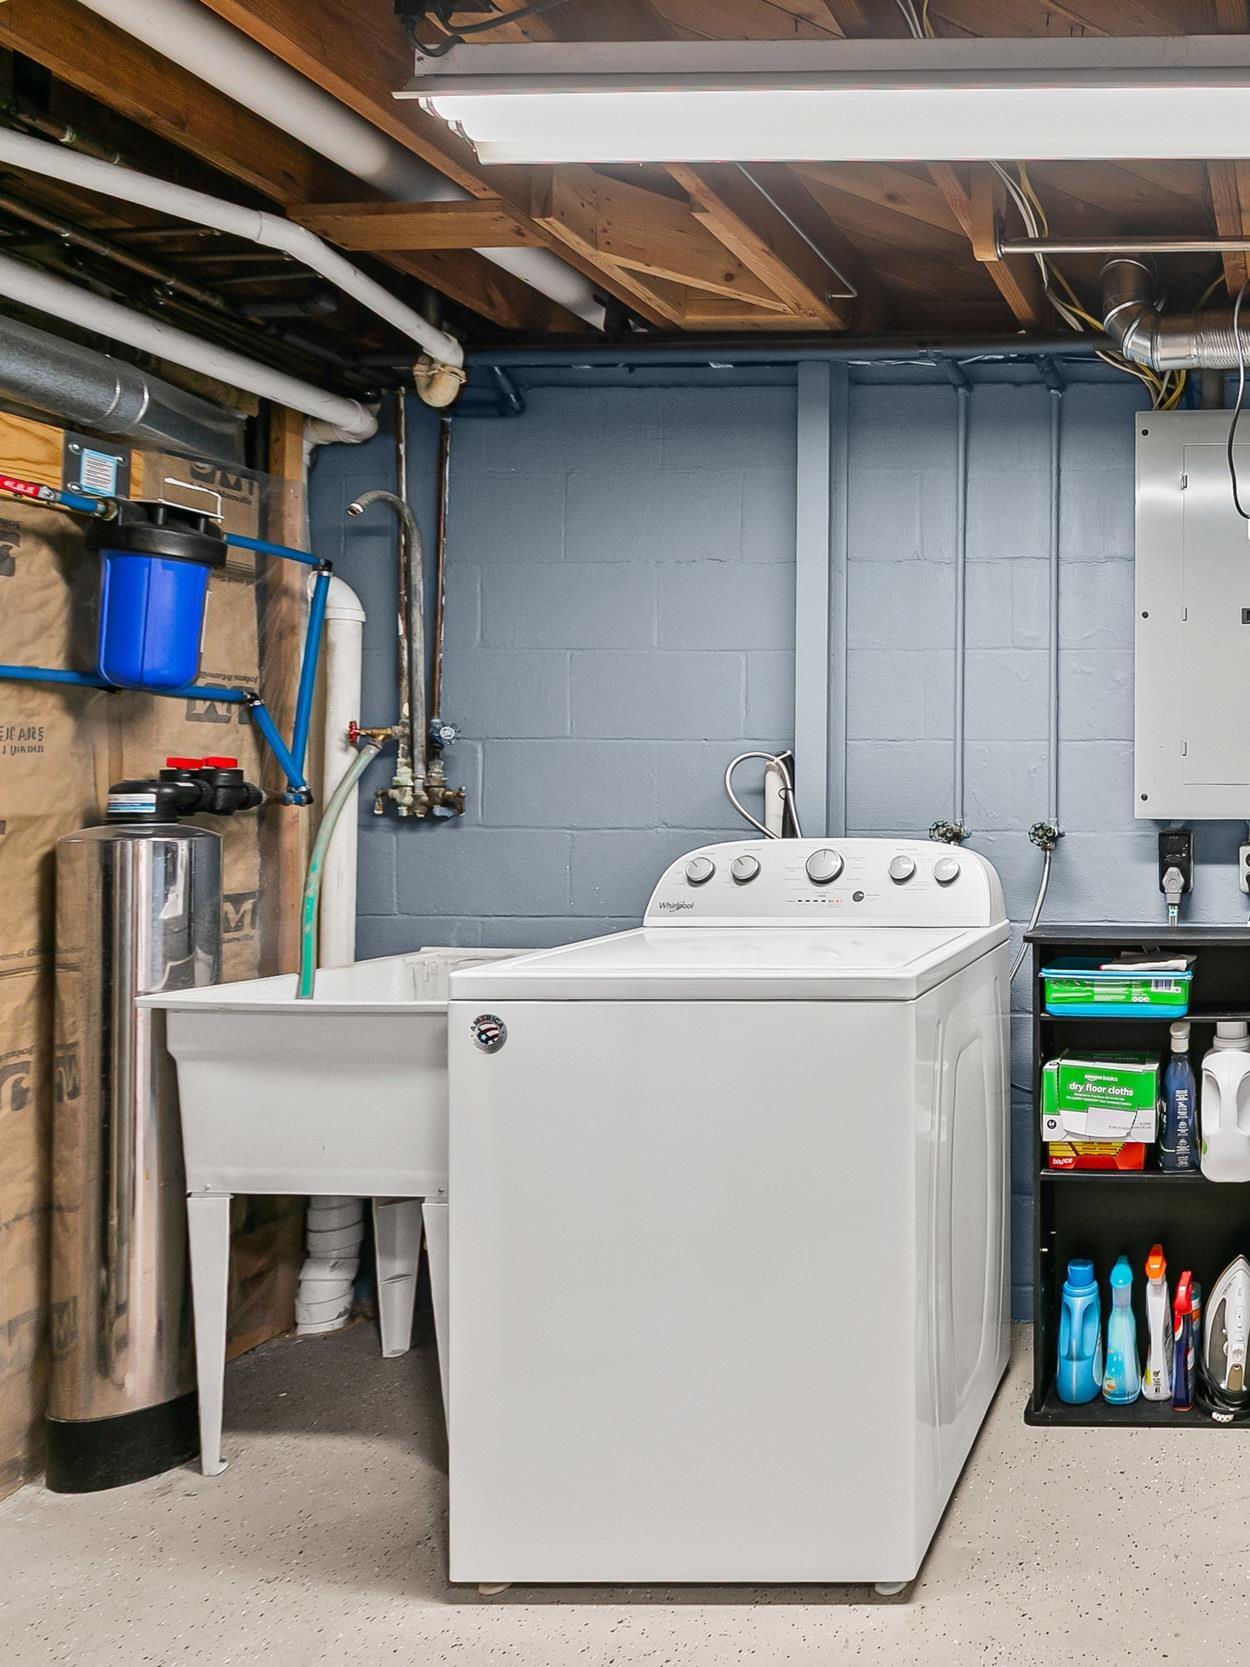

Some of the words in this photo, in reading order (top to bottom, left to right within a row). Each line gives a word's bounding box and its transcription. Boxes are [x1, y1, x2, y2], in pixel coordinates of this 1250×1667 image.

[658, 901, 695, 913] Whirlpool
[1069, 1082, 1084, 1092] dry
[1085, 1083, 1106, 1093] floor
[1107, 1086, 1134, 1096] cloths
